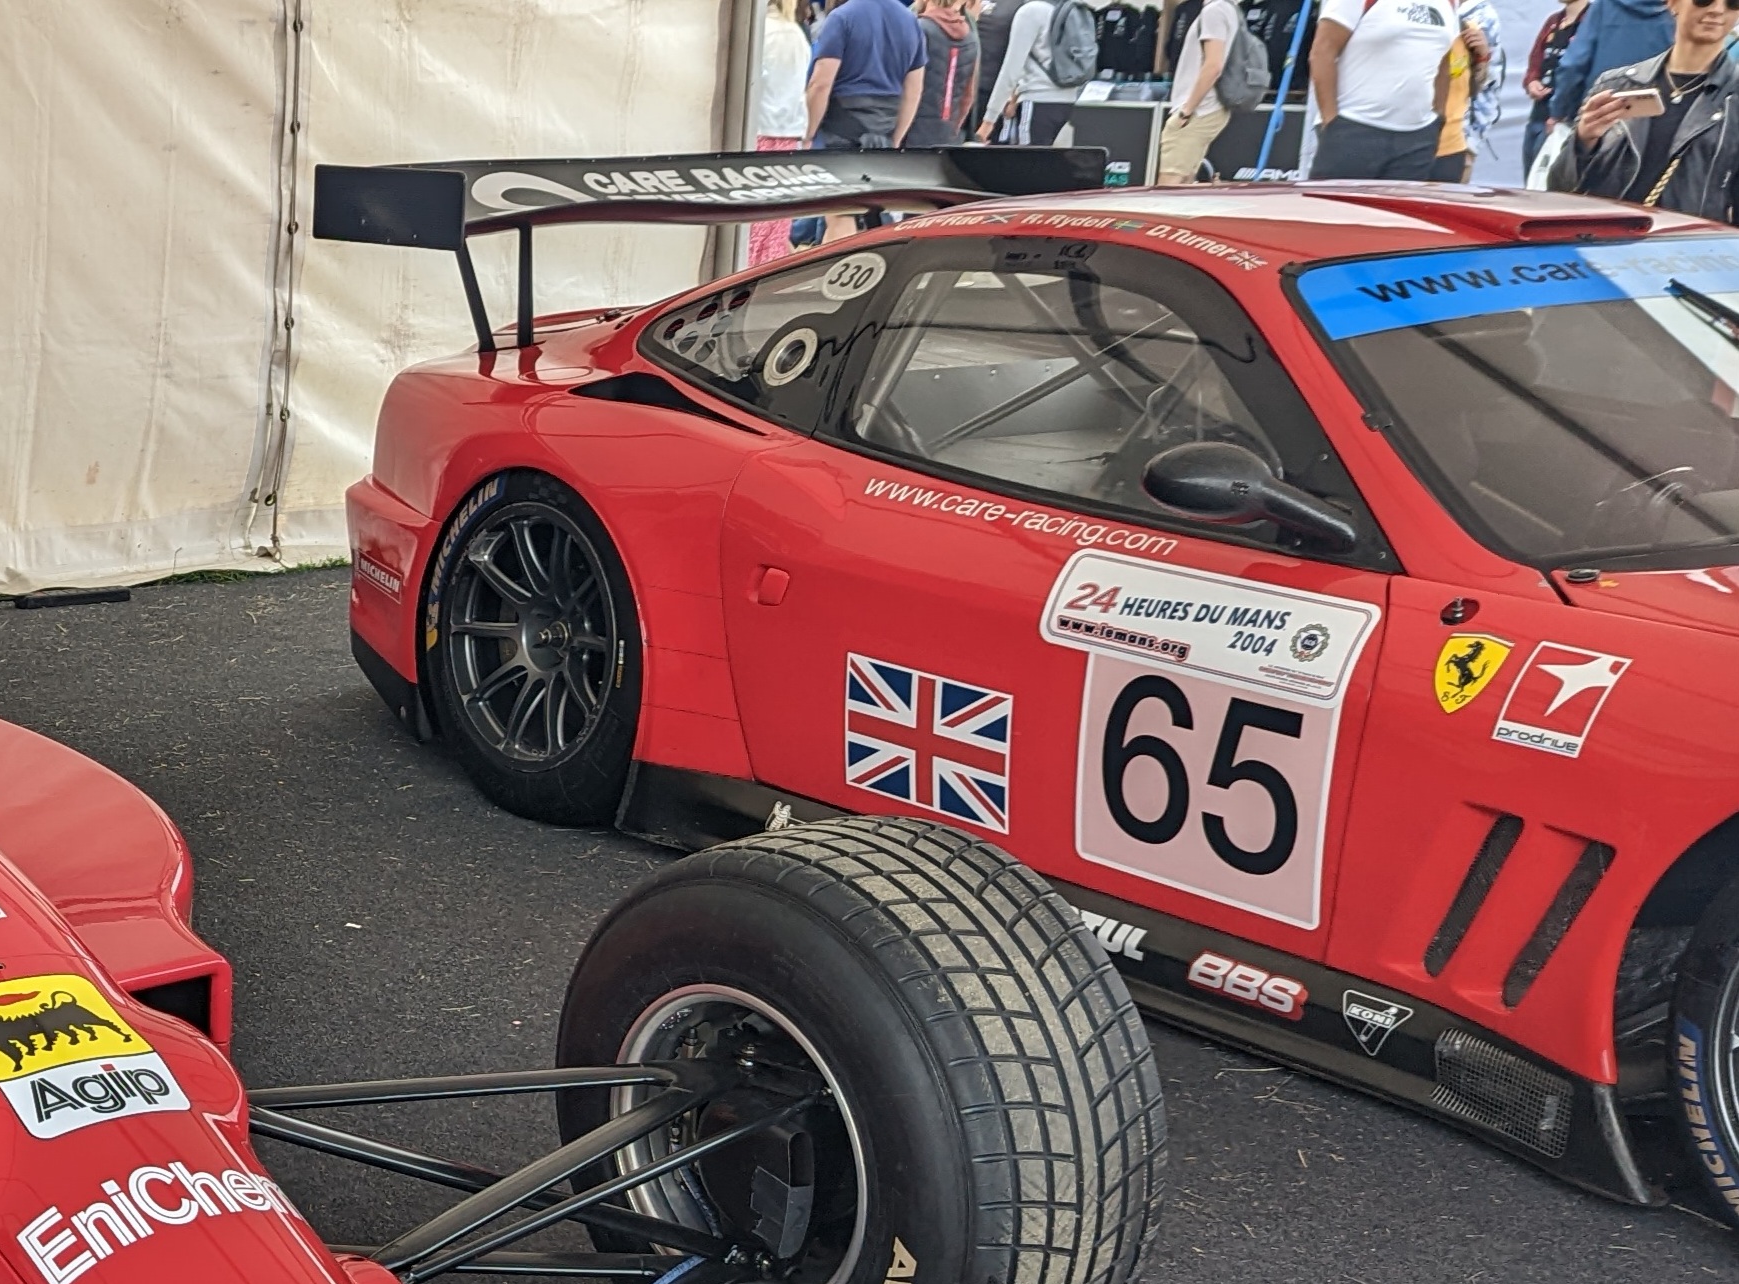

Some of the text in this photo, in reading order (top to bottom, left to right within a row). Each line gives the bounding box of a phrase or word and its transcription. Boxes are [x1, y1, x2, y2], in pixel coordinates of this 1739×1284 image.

[583, 164, 842, 194] CARE RACING
[828, 262, 875, 290] 330
[432, 477, 499, 594] MICHELIN
[864, 477, 1178, 556] www.care-racing.com
[360, 557, 401, 593] MICHELIN
[1064, 582, 1291, 631] 24 HEURES DU MANS
[1057, 615, 1190, 661] www.lemans.org
[1227, 631, 1280, 657] 2004
[1495, 726, 1579, 752] prodrive
[1101, 674, 1304, 876] 65
[1188, 951, 1304, 1014] BBS
[1348, 1004, 1394, 1027] KONI
[29, 1063, 170, 1124] Agip
